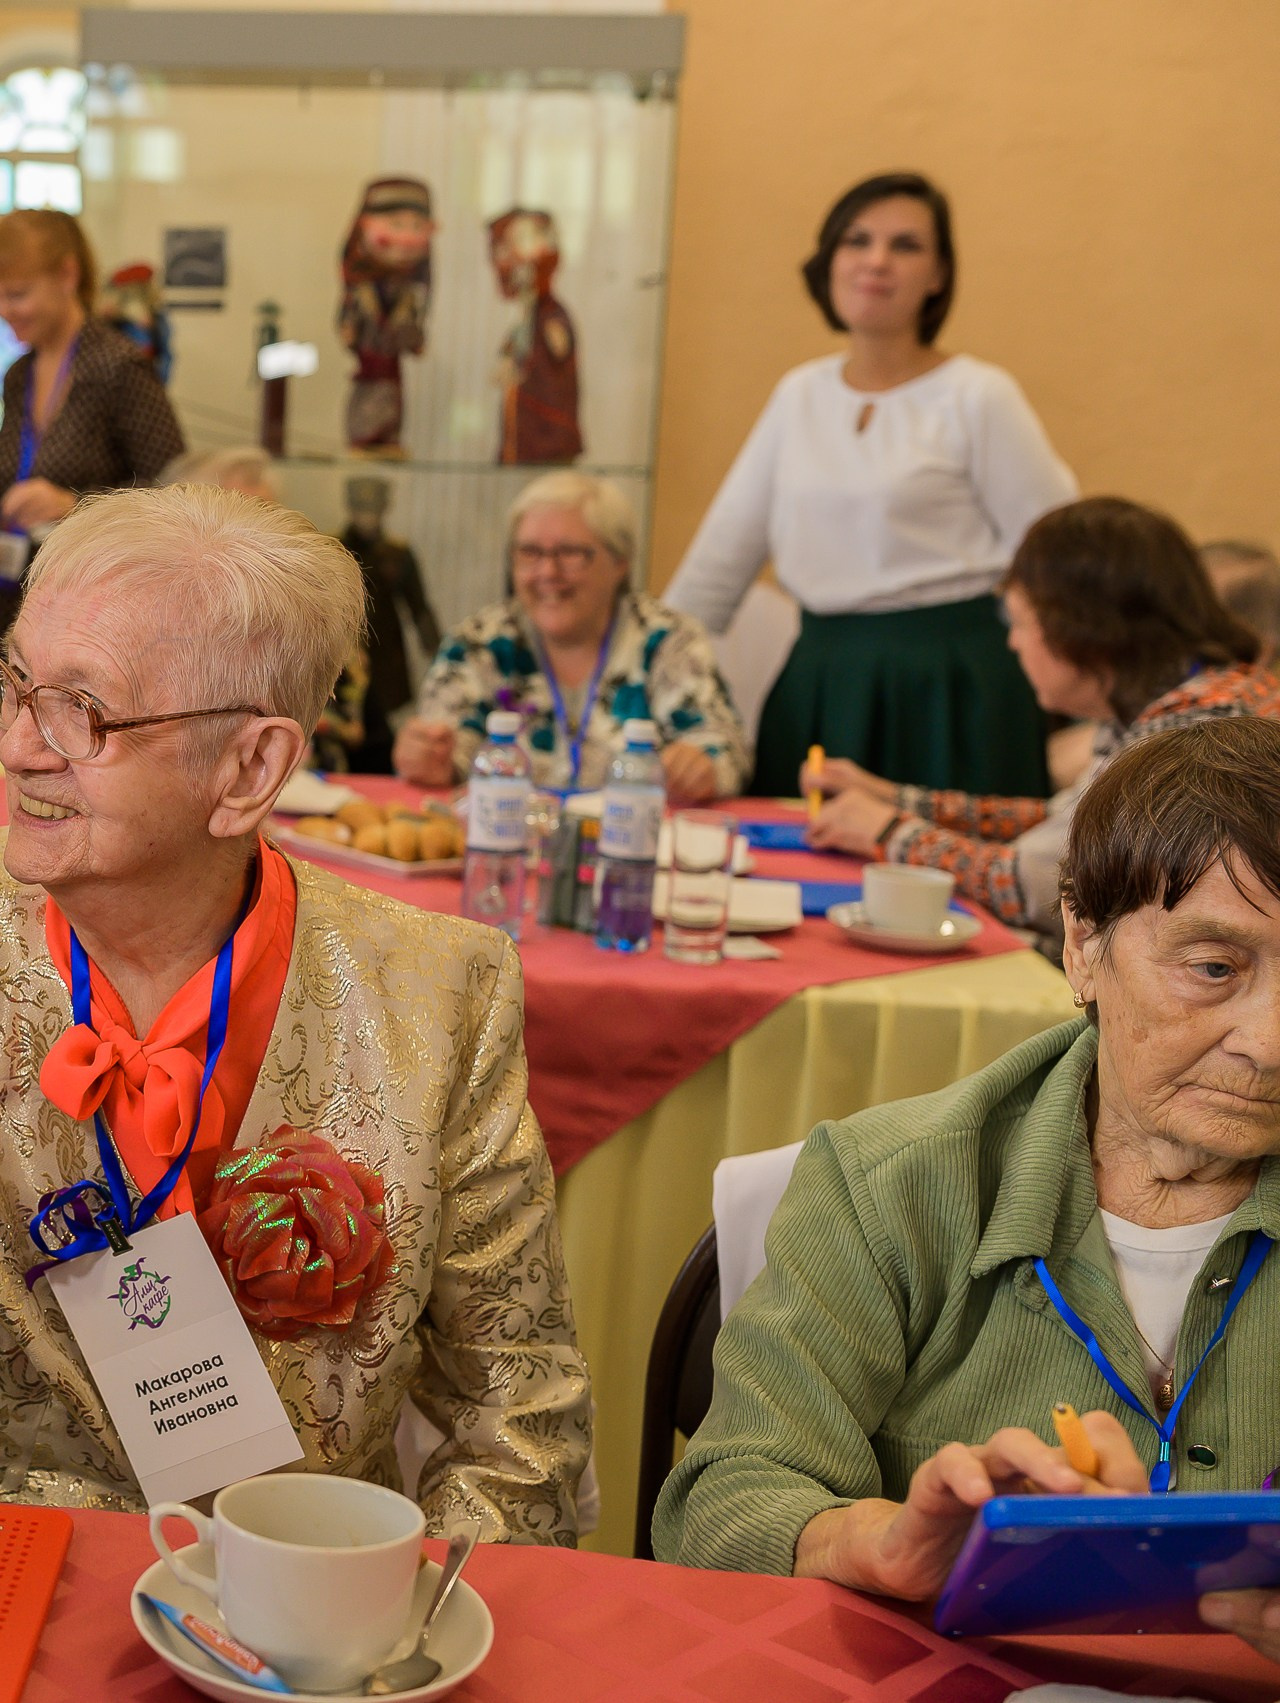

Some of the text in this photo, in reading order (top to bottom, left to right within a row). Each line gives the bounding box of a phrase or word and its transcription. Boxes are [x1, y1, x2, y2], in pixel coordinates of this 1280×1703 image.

[135, 1354, 224, 1398] Макарова
[149, 1374, 229, 1415] Ангелина
[153, 1393, 239, 1435] Ивановна
